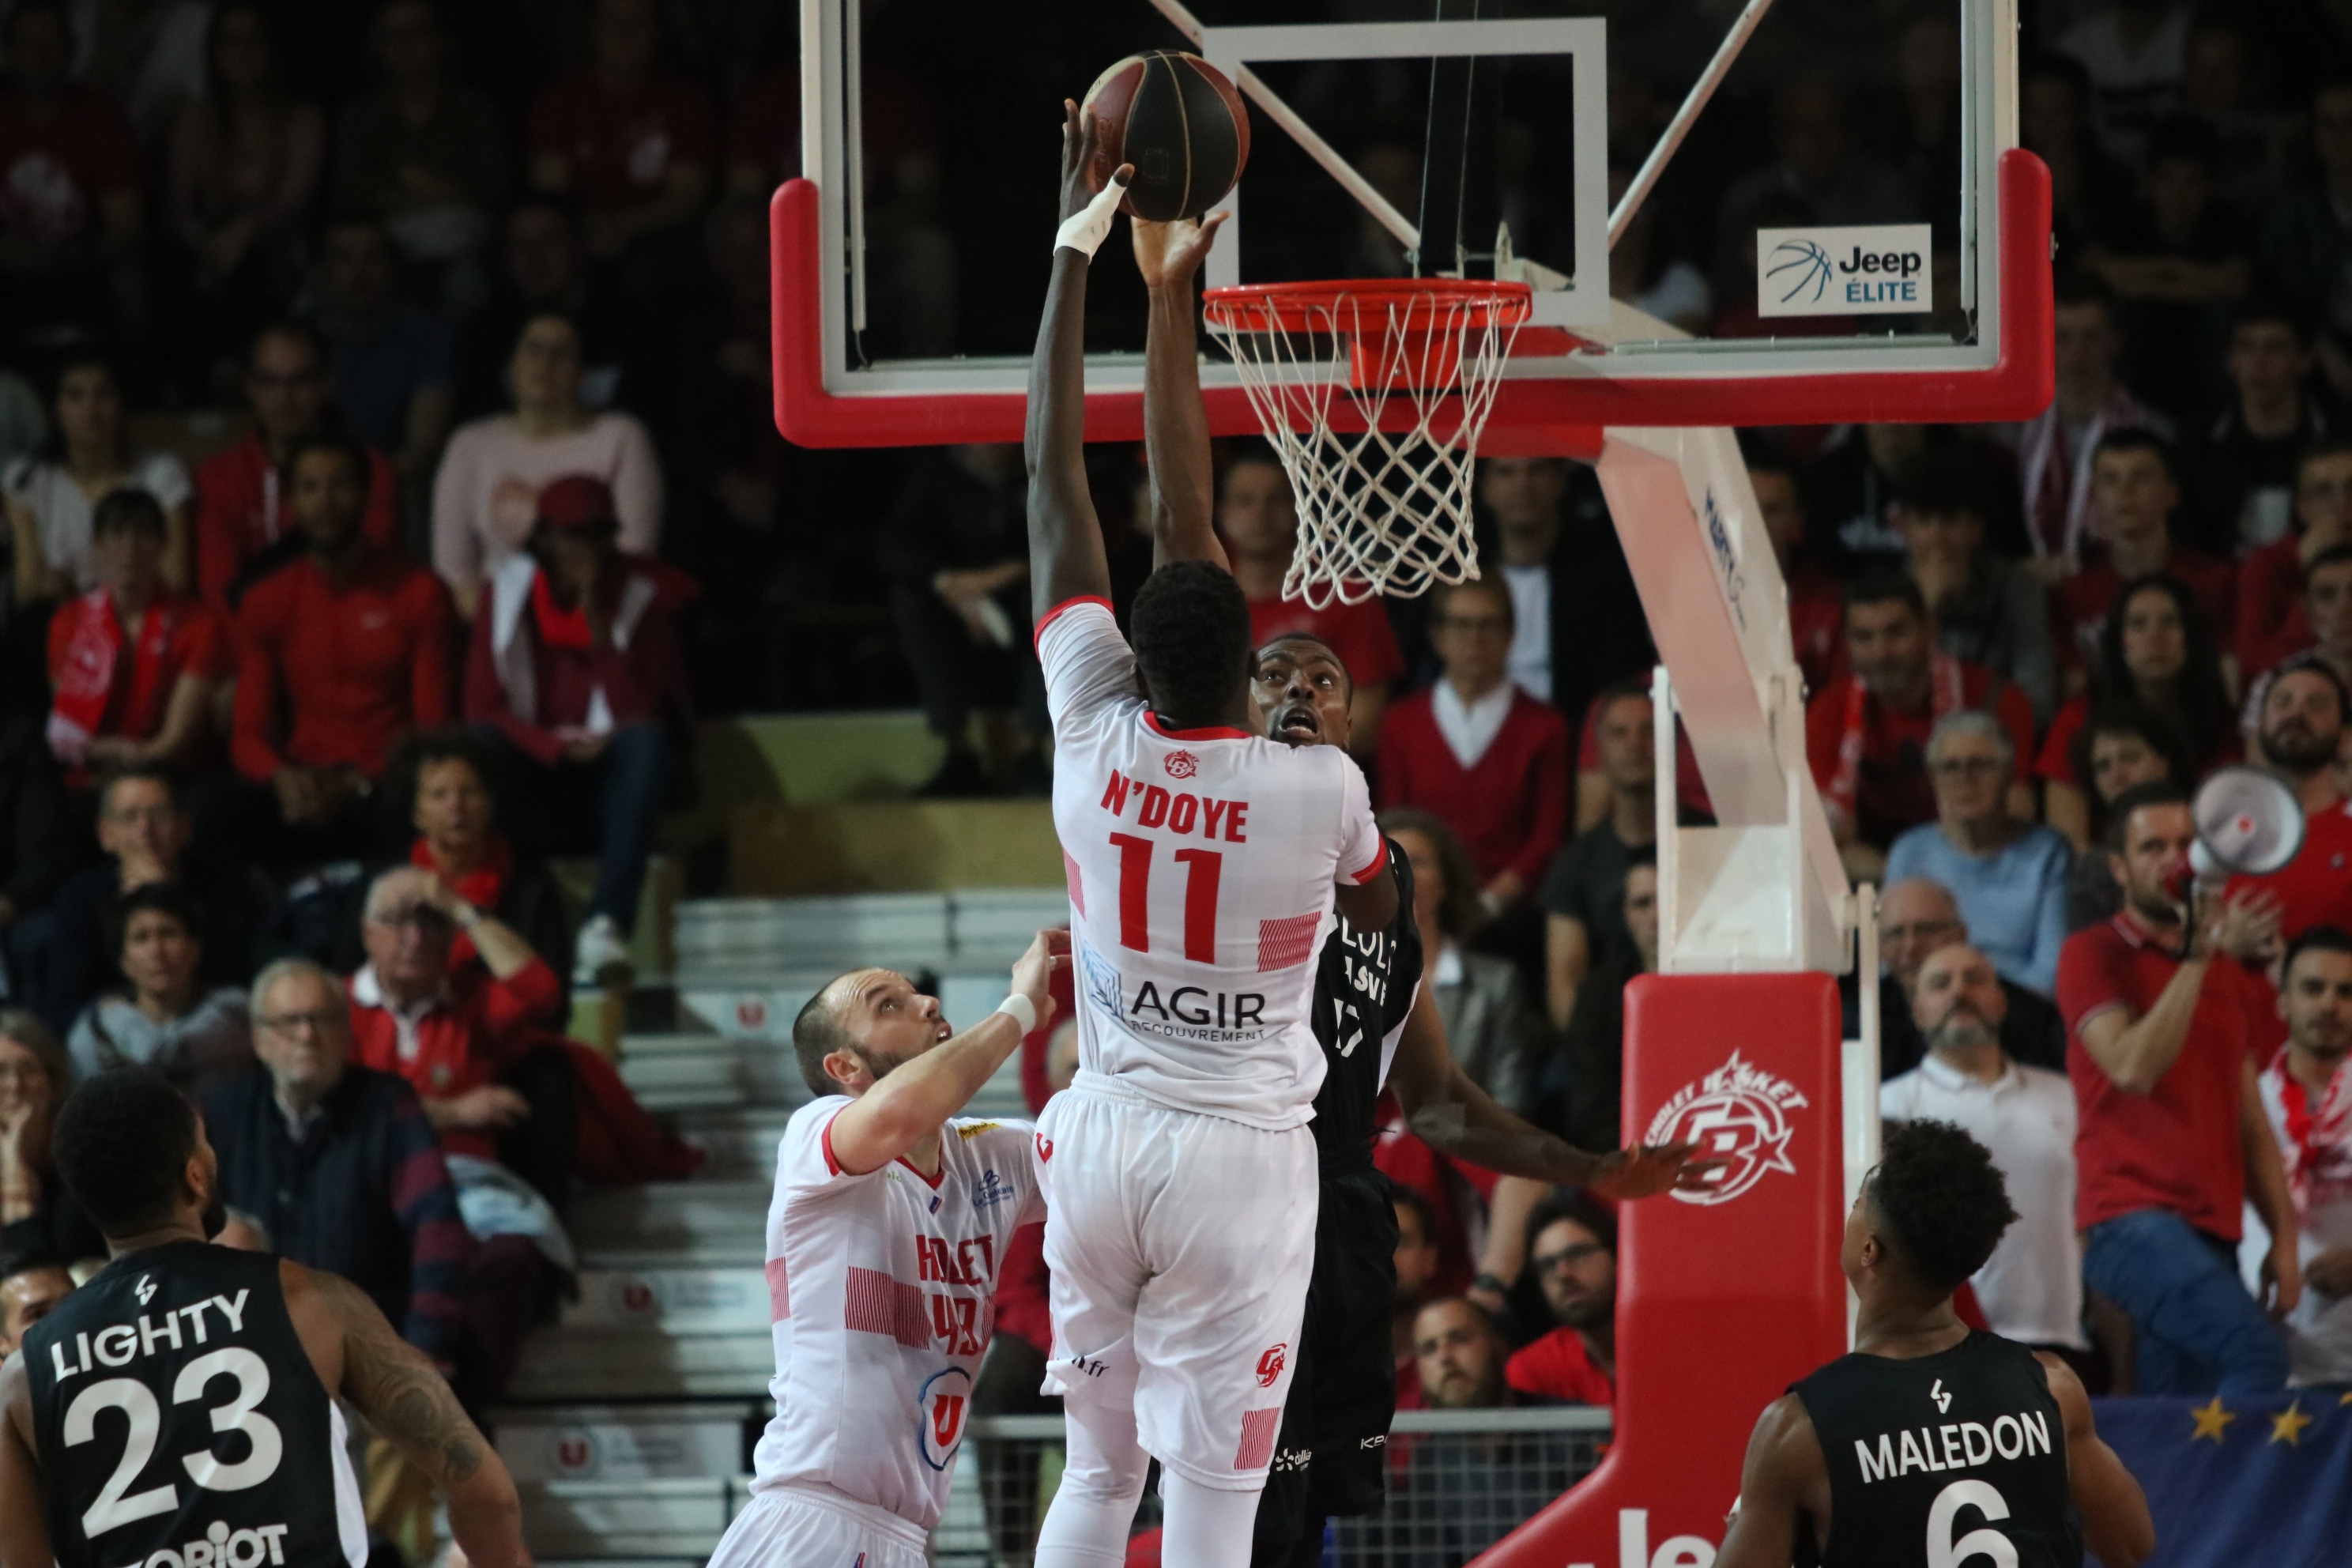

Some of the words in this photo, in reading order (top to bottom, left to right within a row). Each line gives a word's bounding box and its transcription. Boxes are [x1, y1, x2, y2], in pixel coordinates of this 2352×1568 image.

[1839, 247, 1922, 277] Jeep
[1846, 278, 1917, 303] ÉLITE
[1100, 768, 1249, 843] N'DOYE
[1109, 832, 1222, 964] 11
[1131, 981, 1265, 1029] AGIR
[1131, 1020, 1265, 1042] RECOUVREMENT
[51, 1288, 251, 1383] LIGHTY
[64, 1346, 283, 1540] 23
[1854, 1410, 2052, 1484] MALEDON
[1926, 1479, 2018, 1568] 6
